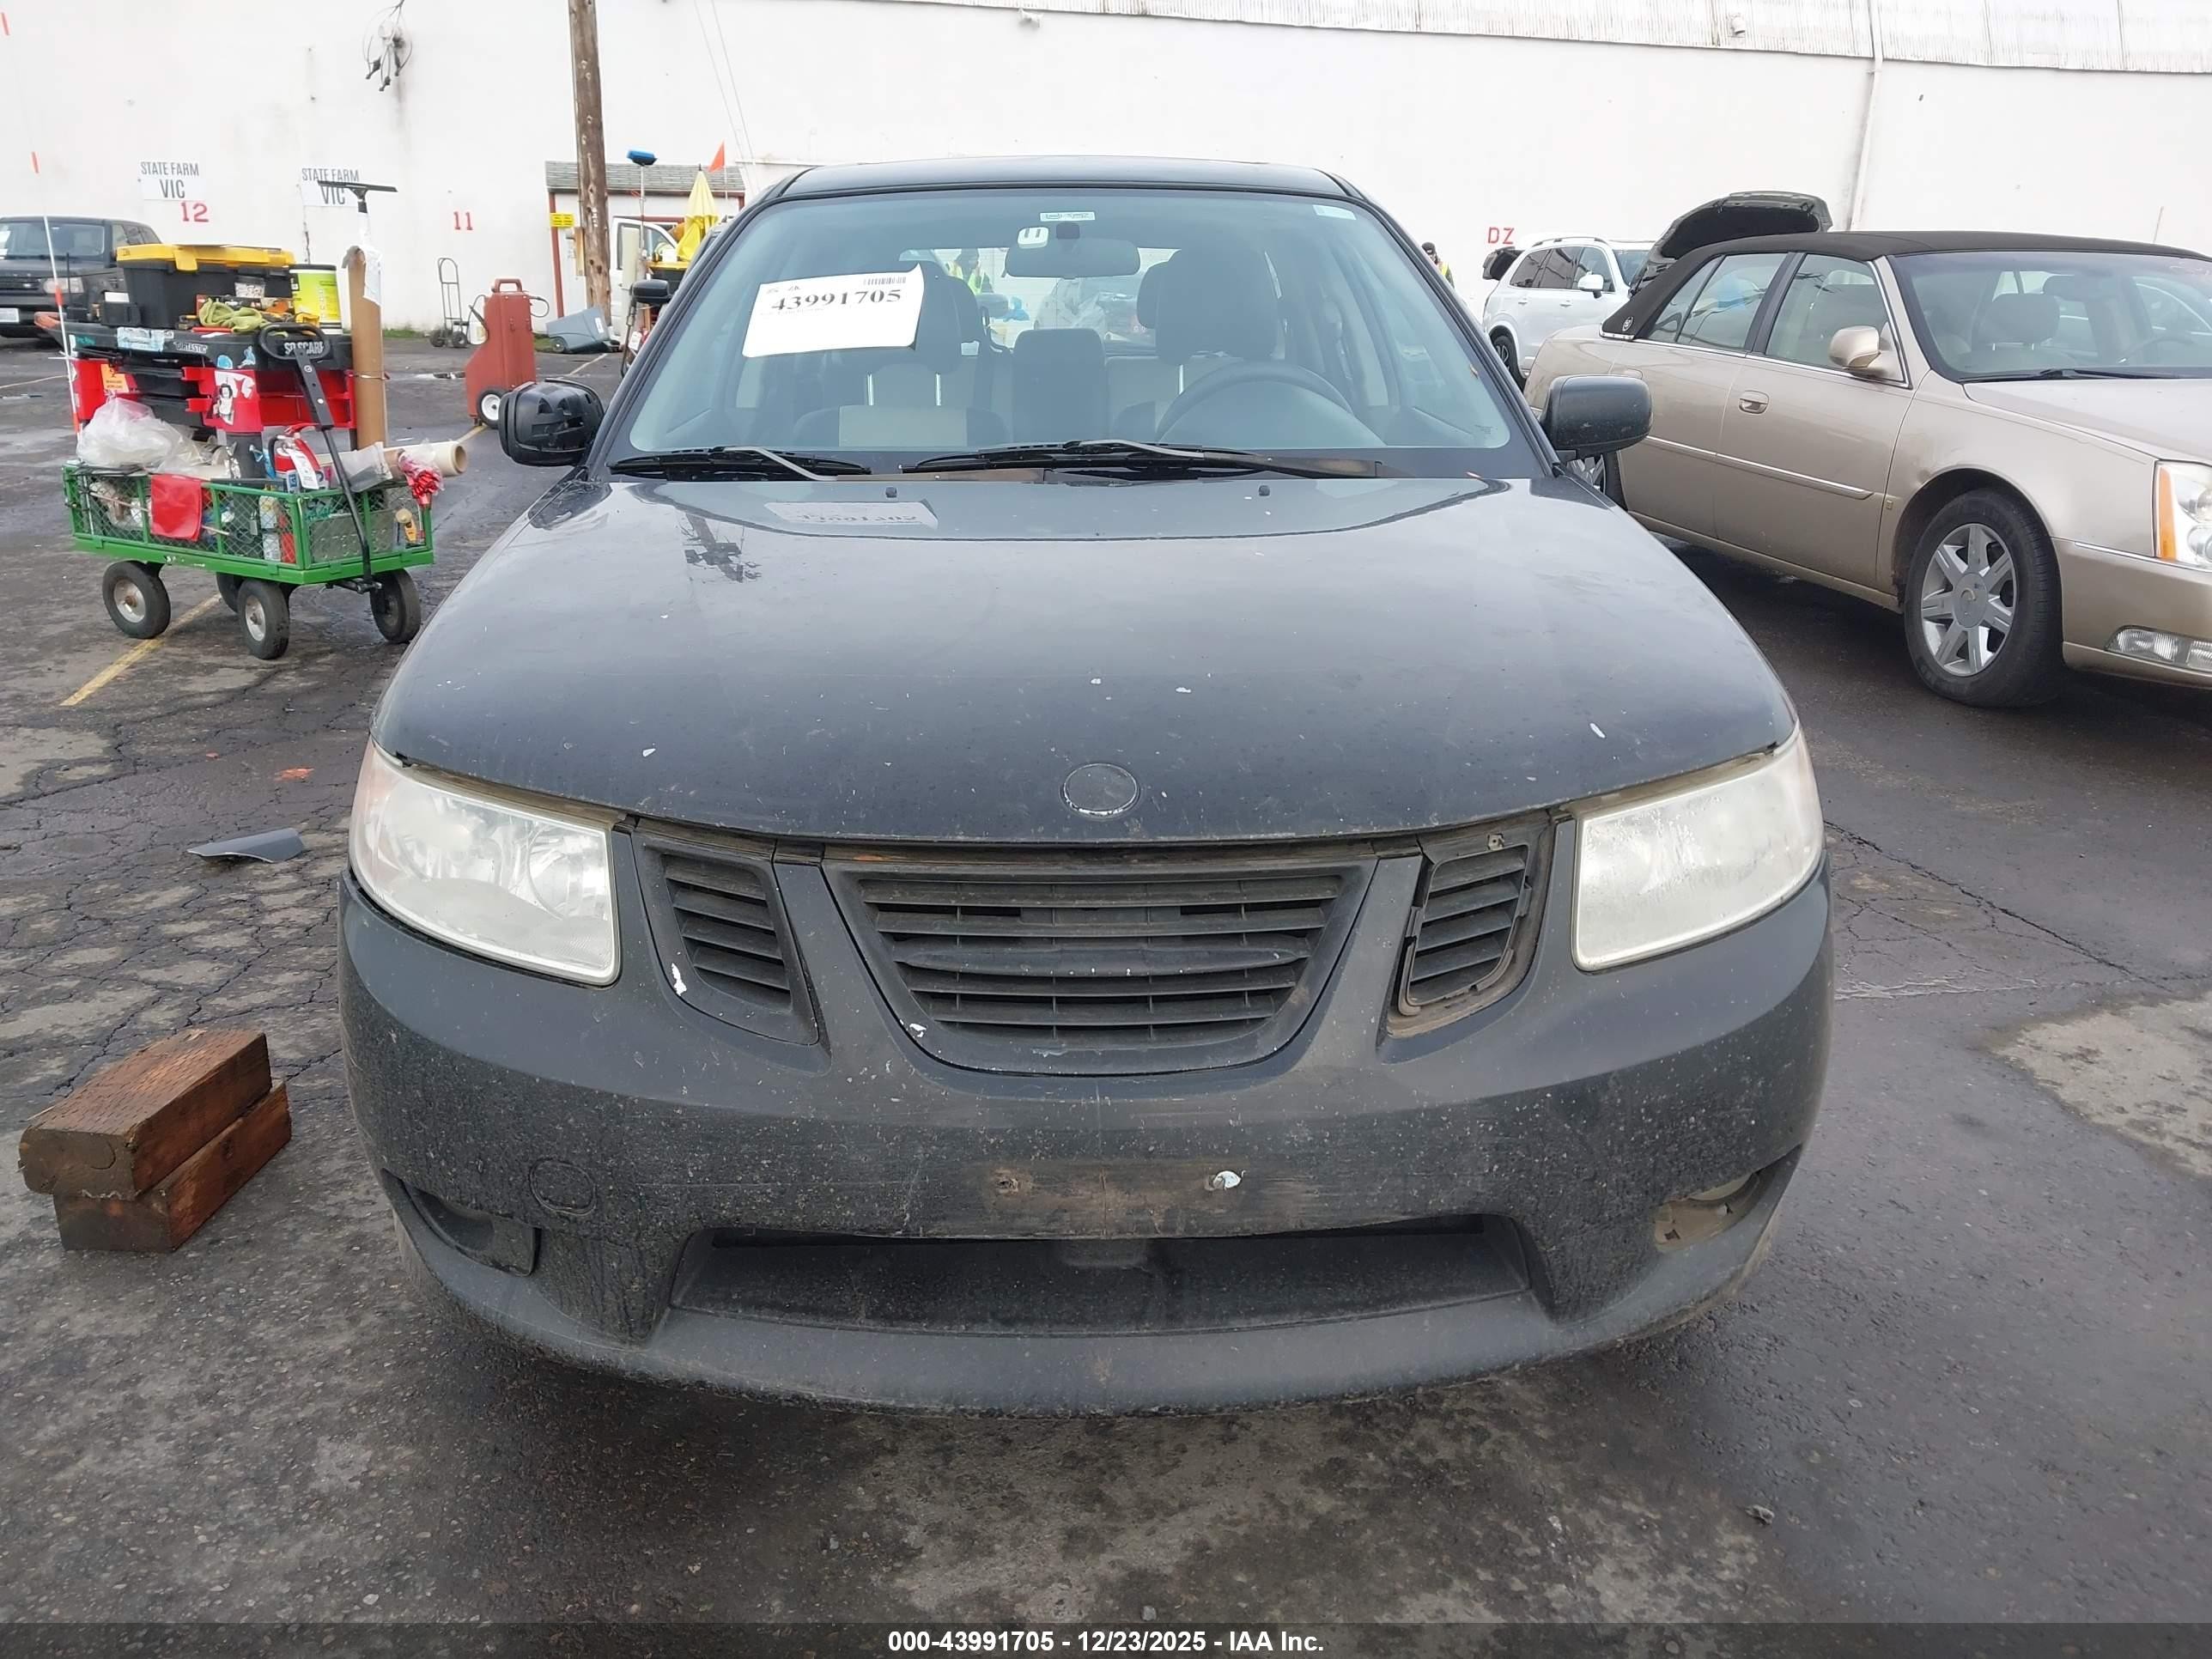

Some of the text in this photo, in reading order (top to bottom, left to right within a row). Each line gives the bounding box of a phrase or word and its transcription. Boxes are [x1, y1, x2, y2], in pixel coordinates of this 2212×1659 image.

[140, 161, 199, 177] STATE FARM
[301, 167, 359, 182] STATE FARM
[159, 179, 185, 198] VIC
[319, 185, 345, 204] VIC
[180, 202, 210, 222] 12
[453, 211, 473, 231] 11
[771, 289, 902, 311] 43991705
